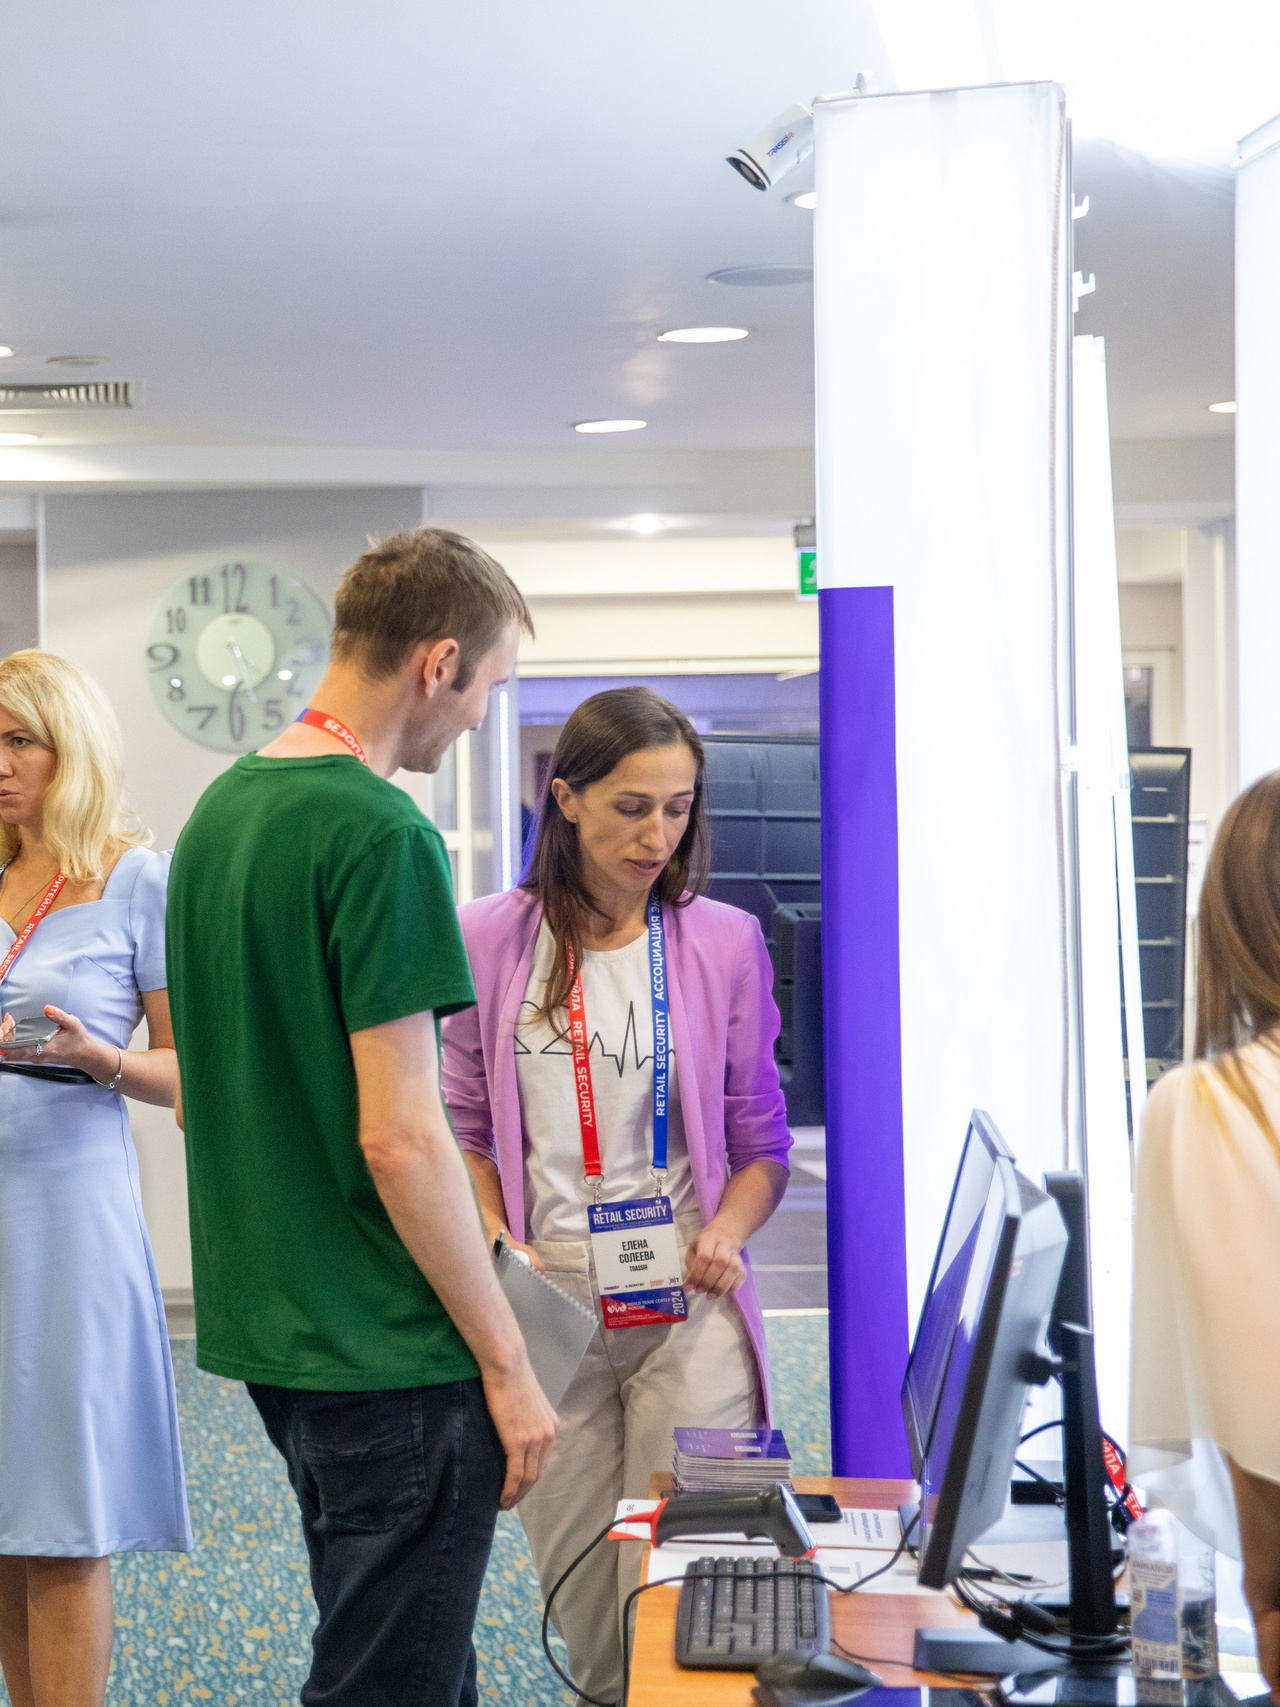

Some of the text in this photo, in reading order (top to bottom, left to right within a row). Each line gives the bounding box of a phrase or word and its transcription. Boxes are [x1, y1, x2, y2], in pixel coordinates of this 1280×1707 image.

[188, 576, 211, 605] 11
[221, 563, 248, 613] 12
[269, 575, 279, 608] 1
[166, 607, 186, 634] 10
[286, 598, 301, 625] 2
[147, 642, 179, 673] 9
[187, 706, 217, 730] 7
[229, 680, 246, 742] 6
[263, 699, 283, 730] 5
[323, 719, 366, 766] БЕЗОПА
[34, 874, 65, 918] РИТЕЙЛА
[11, 922, 35, 953] RETAIL
[651, 915, 665, 1001] АССОЦИАЦИЯ
[573, 1020, 587, 1065] RETAIL
[655, 1010, 666, 1070] SECURITY
[577, 1066, 593, 1128] SECURITY
[656, 1072, 666, 1116] RETAIL
[593, 1211, 624, 1225] RETAIL
[625, 1205, 667, 1221] SECURITY
[619, 1250, 655, 1264] СОЛЕЕВА
[622, 1239, 649, 1251] ЕЛЕНА
[671, 1290, 685, 1315] 2024
